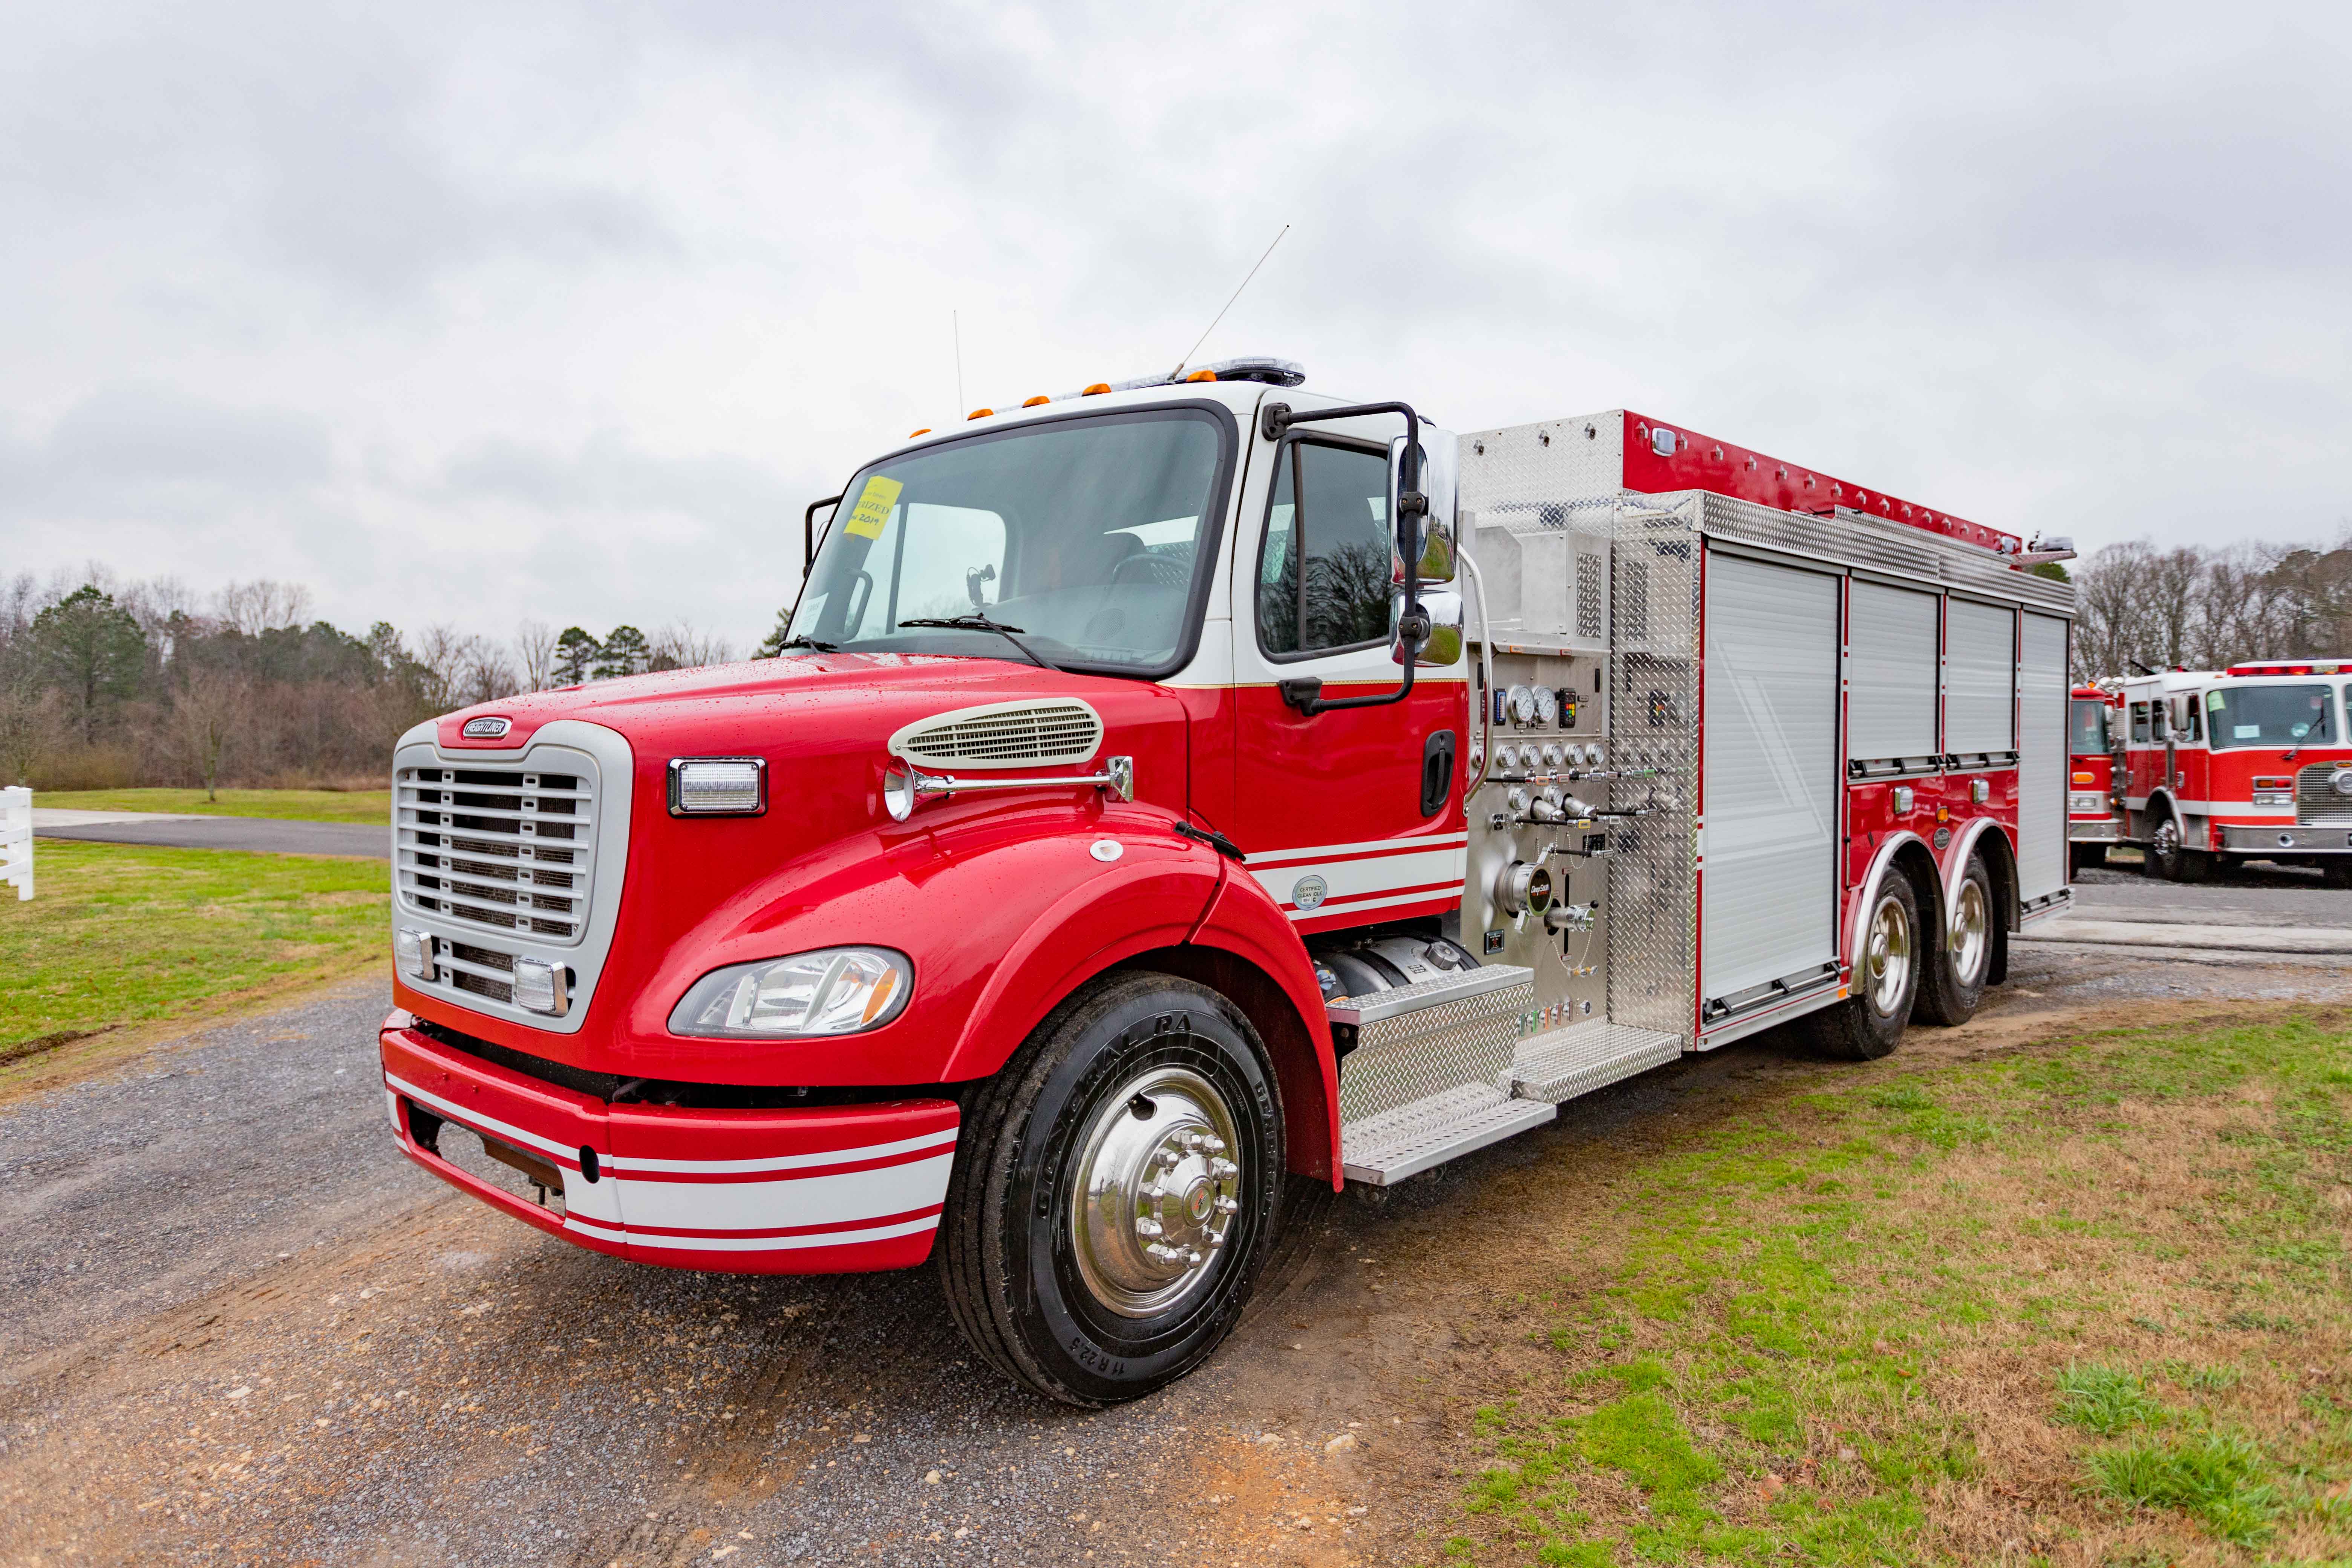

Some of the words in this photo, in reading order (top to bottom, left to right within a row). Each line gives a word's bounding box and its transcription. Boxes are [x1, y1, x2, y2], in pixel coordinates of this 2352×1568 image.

[466, 721, 505, 732] FREIGHTLINER
[1036, 1031, 1139, 1220] GENERAL
[1153, 1014, 1193, 1037] RA
